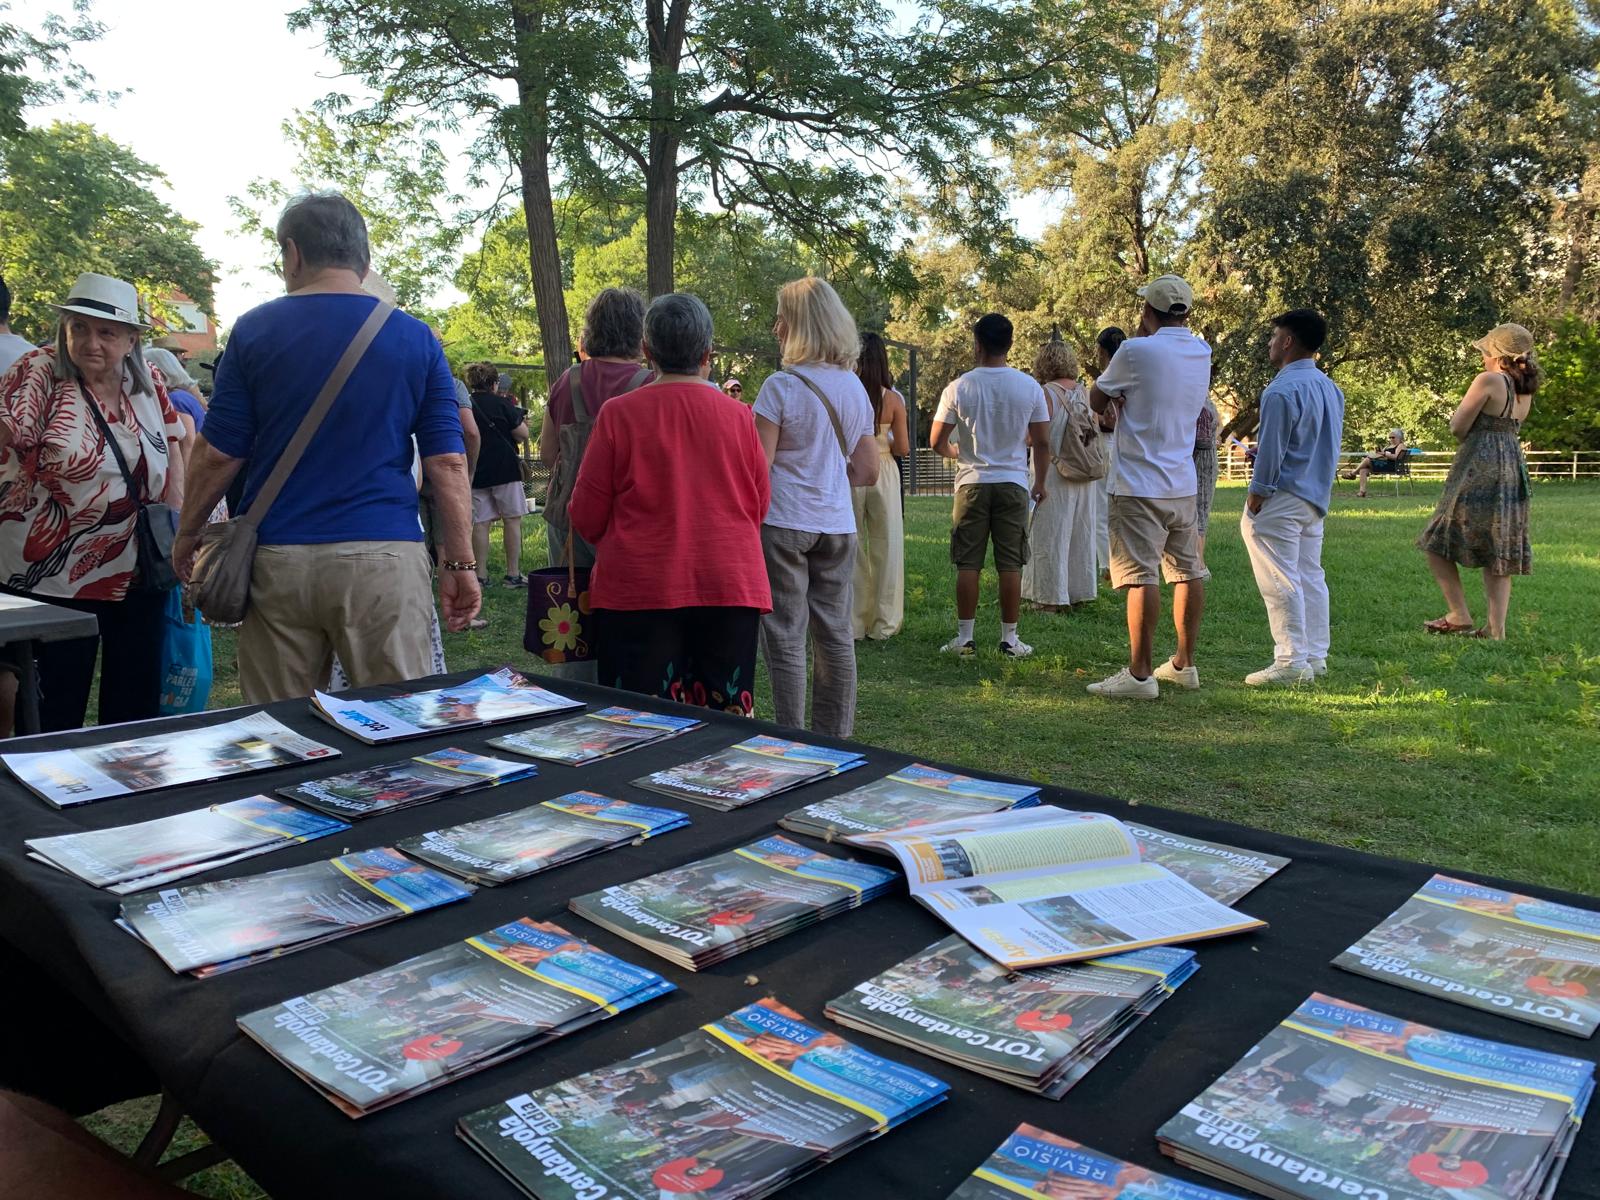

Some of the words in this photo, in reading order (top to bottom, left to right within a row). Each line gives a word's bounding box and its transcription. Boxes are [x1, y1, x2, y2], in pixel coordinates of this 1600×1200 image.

[806, 810, 886, 832] erdanyola
[601, 896, 683, 935] Cerdanyola
[678, 925, 713, 946] TOT
[1360, 958, 1514, 1007] Cerdanyola
[745, 1012, 809, 1044] REVISIÓ
[860, 996, 991, 1047] Cerdanyola
[1311, 1006, 1398, 1033] REVISIÓ
[1514, 1002, 1585, 1025] TOT
[274, 1011, 362, 1078] Cerdanyola
[993, 1036, 1047, 1063] TOT
[356, 1061, 399, 1092] TOT
[885, 1076, 926, 1096] VIRGEN
[707, 1095, 738, 1112] Carrer
[1367, 1088, 1410, 1106] Carrer
[518, 1096, 561, 1134] aldia
[1197, 1108, 1260, 1141] aldia
[760, 1122, 797, 1141] Comerç
[499, 1116, 609, 1200] Cerdanyola
[1014, 1146, 1106, 1180] REVISIÓ
[1195, 1123, 1390, 1200] Cerdanyola
